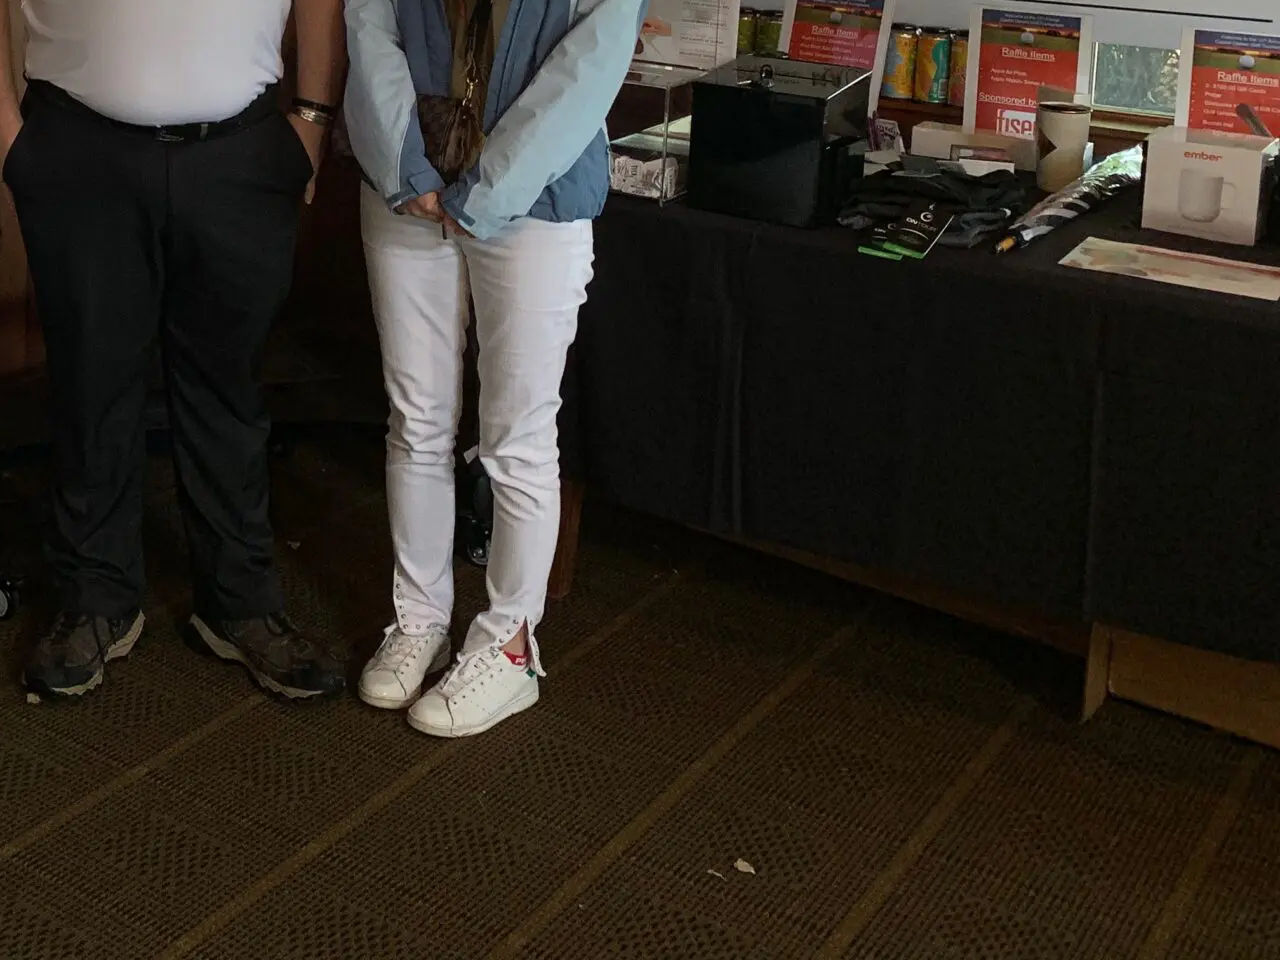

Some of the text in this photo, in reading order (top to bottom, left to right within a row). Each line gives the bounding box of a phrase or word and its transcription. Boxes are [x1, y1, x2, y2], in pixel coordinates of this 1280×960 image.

[1002, 46, 1055, 61] Raffle Items
[1217, 71, 1279, 86] Raffle Items
[979, 91, 1026, 106] Sponsored
[1183, 150, 1223, 162] ember
